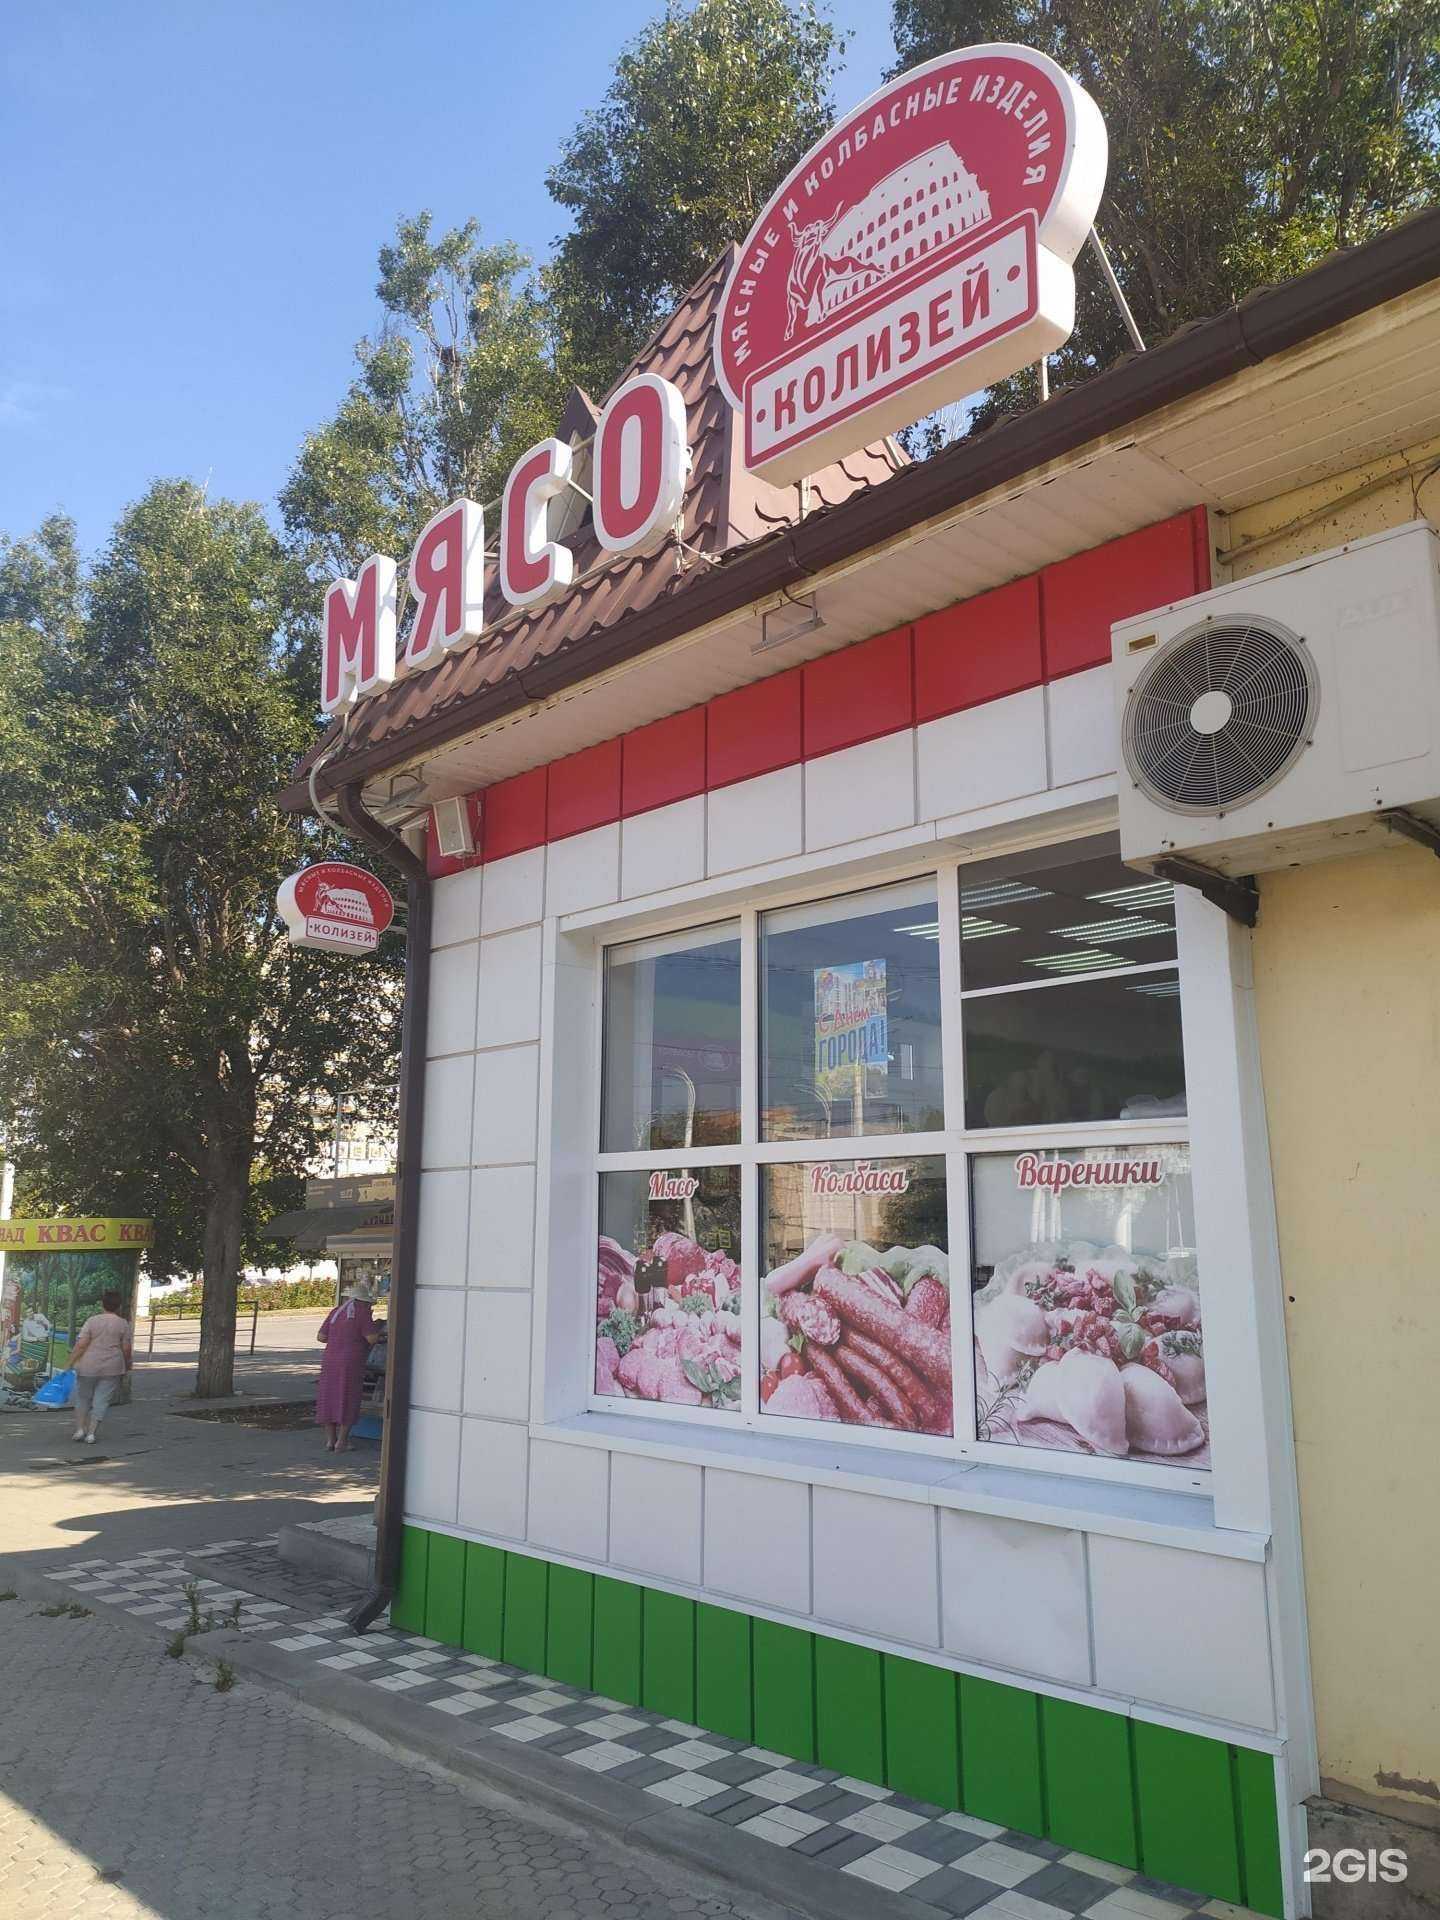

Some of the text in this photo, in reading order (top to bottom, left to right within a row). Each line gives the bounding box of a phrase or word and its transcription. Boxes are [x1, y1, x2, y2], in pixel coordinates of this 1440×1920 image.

[731, 73, 1051, 367] МЯСНЫЕ И КОЛБАСНЫЕ ИЗДЕЛИЯ
[773, 262, 990, 432] КОЛИЗЕЙ
[323, 375, 678, 710] МЯСО
[313, 923, 372, 943] КОЛИЗЕЙ
[818, 1019, 887, 1073] ГОРОДА!
[649, 1171, 696, 1199] Мясо
[811, 1160, 907, 1193] Колбаса
[1016, 1155, 1162, 1194] Вареники
[37, 1224, 107, 1243] КВАС
